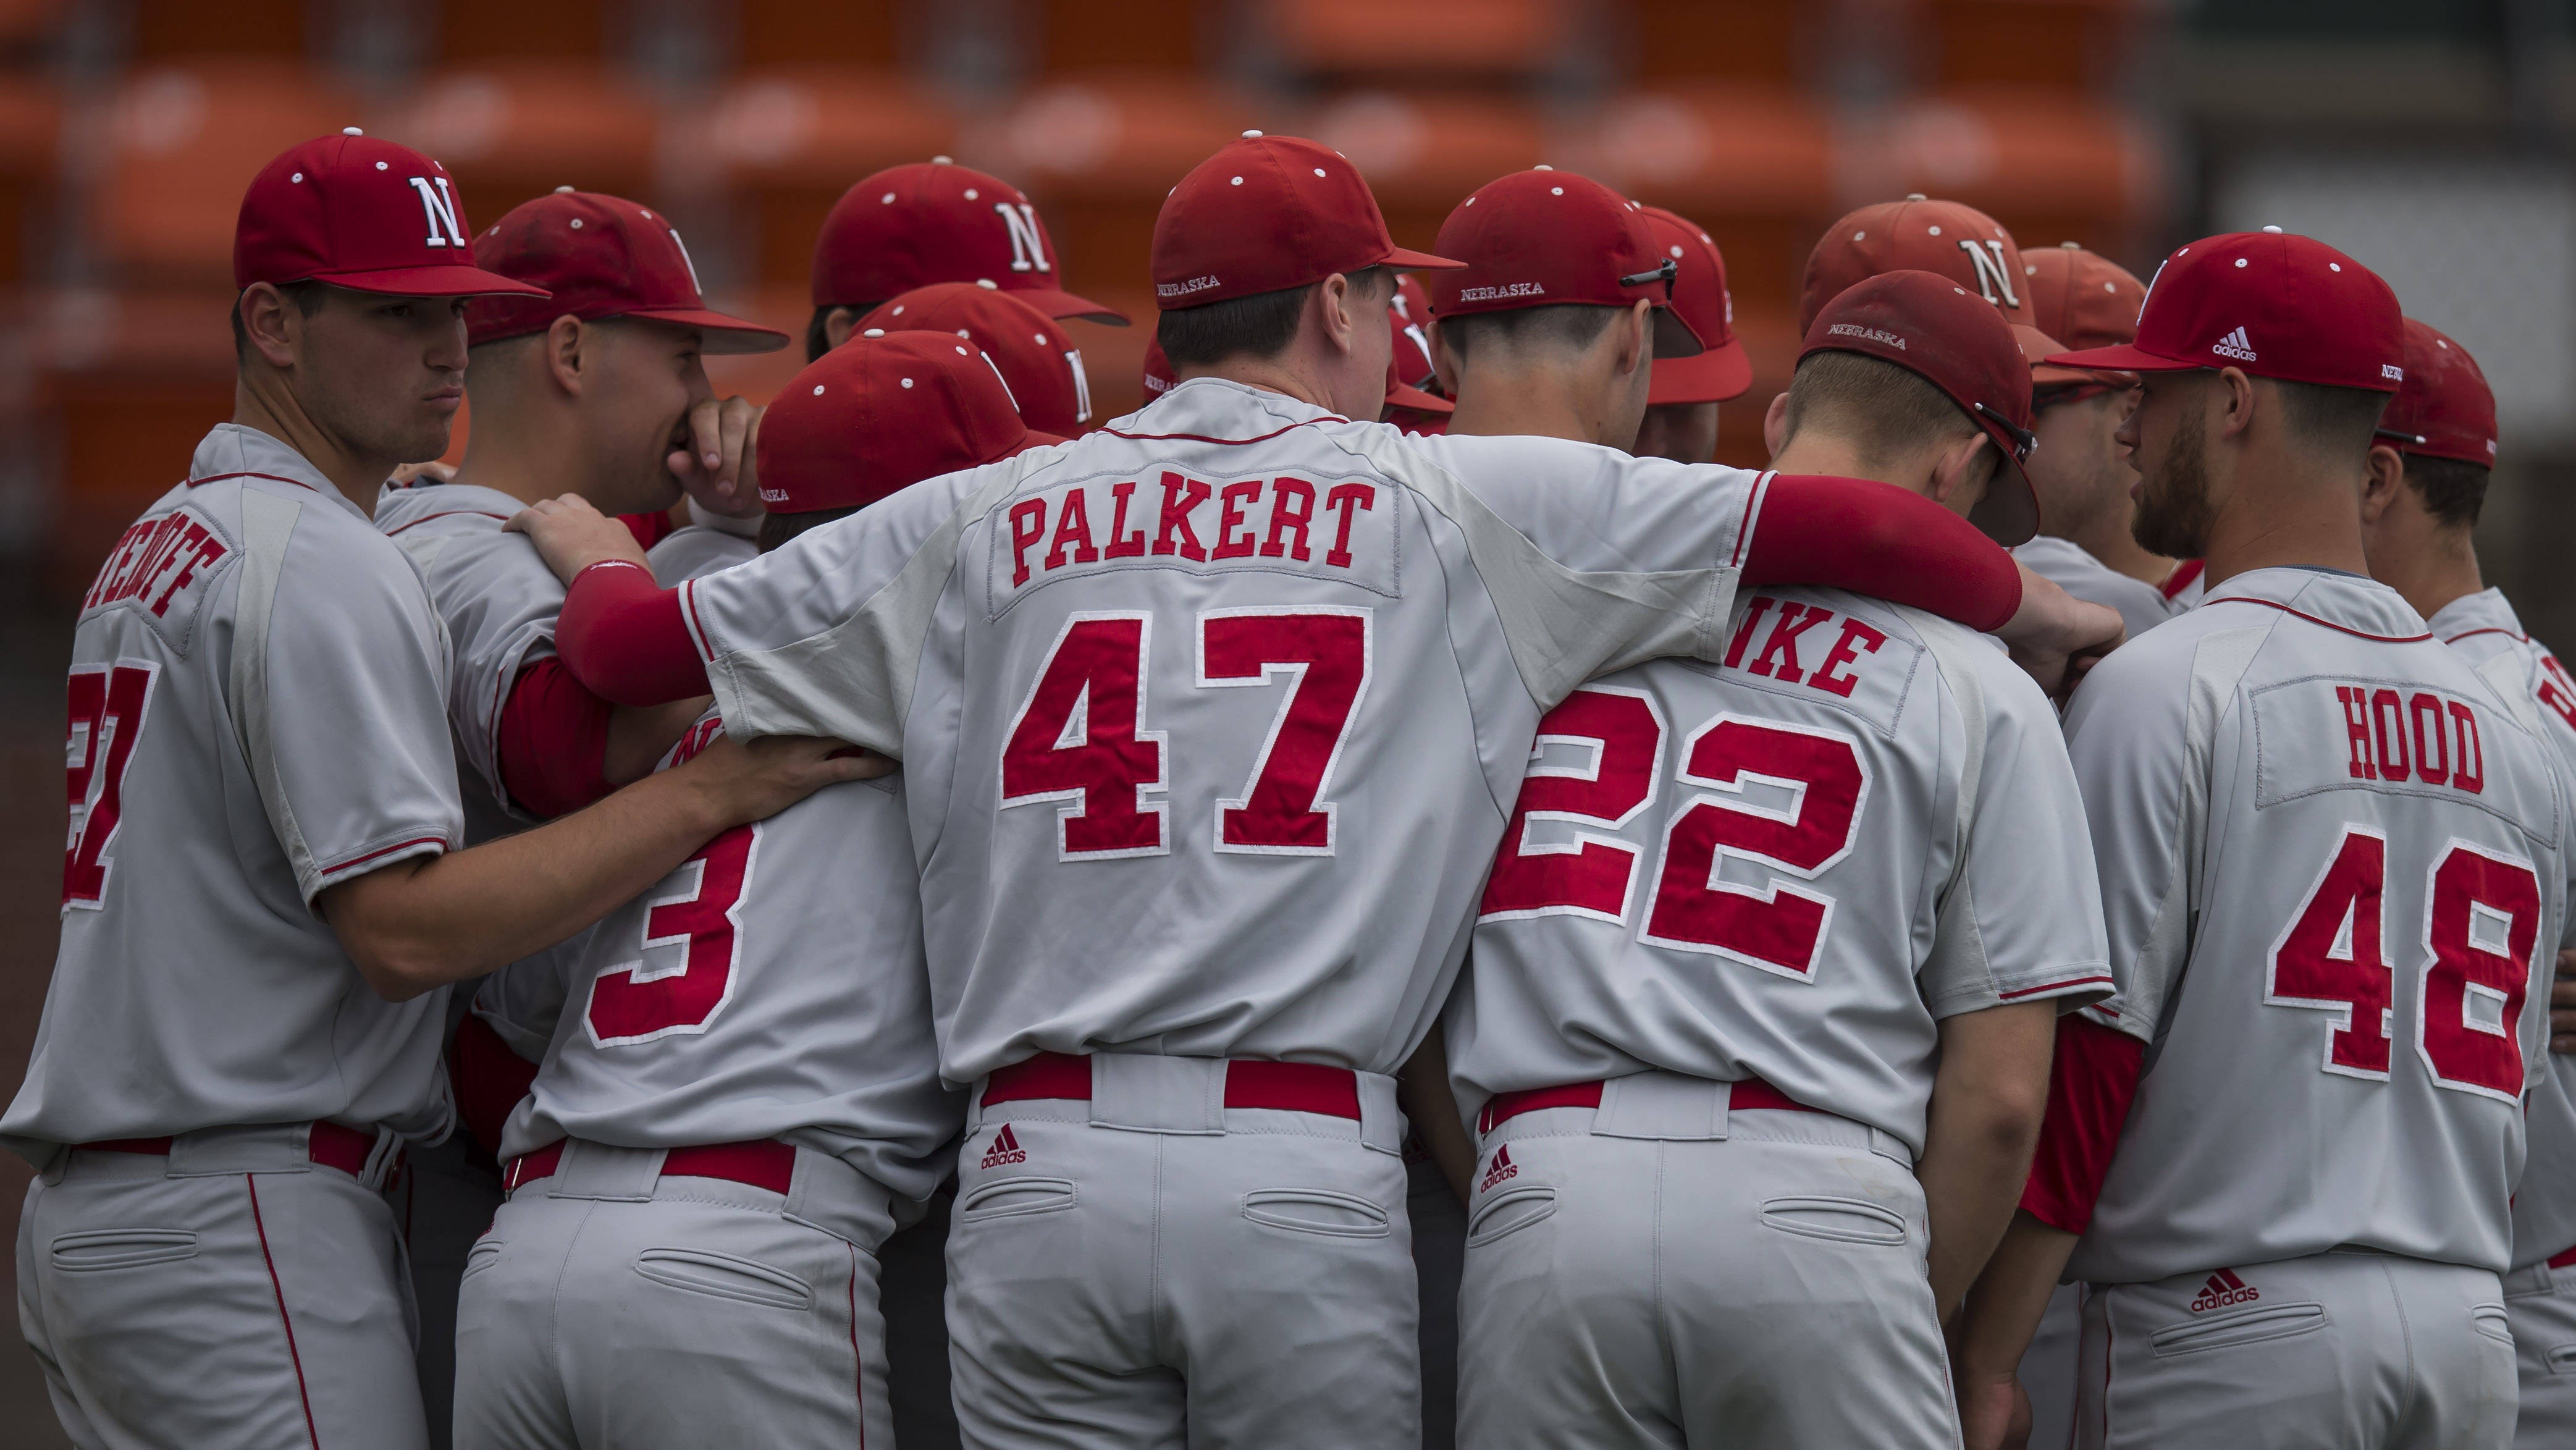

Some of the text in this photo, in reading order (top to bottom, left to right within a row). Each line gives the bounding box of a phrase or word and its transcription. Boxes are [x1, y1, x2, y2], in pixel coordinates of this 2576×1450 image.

[407, 176, 465, 250] N
[993, 202, 1051, 272] N
[1157, 275, 1221, 297] NEBRASKA
[1460, 282, 1544, 302] NEBRASKA
[1956, 238, 2019, 309] N
[1827, 324, 1906, 351] NEBRASKA
[2212, 344, 2257, 361] adidas
[1009, 471, 1375, 589] PALKERT
[999, 605, 1373, 862] 47
[2336, 686, 2485, 795] HOOD
[1476, 684, 1872, 985] 22
[582, 822, 764, 1050] 3
[2263, 822, 2543, 1106] 48
[981, 1150, 1027, 1170] adidas
[1480, 1165, 1518, 1194] adidas
[2191, 1287, 2260, 1312] adidas
